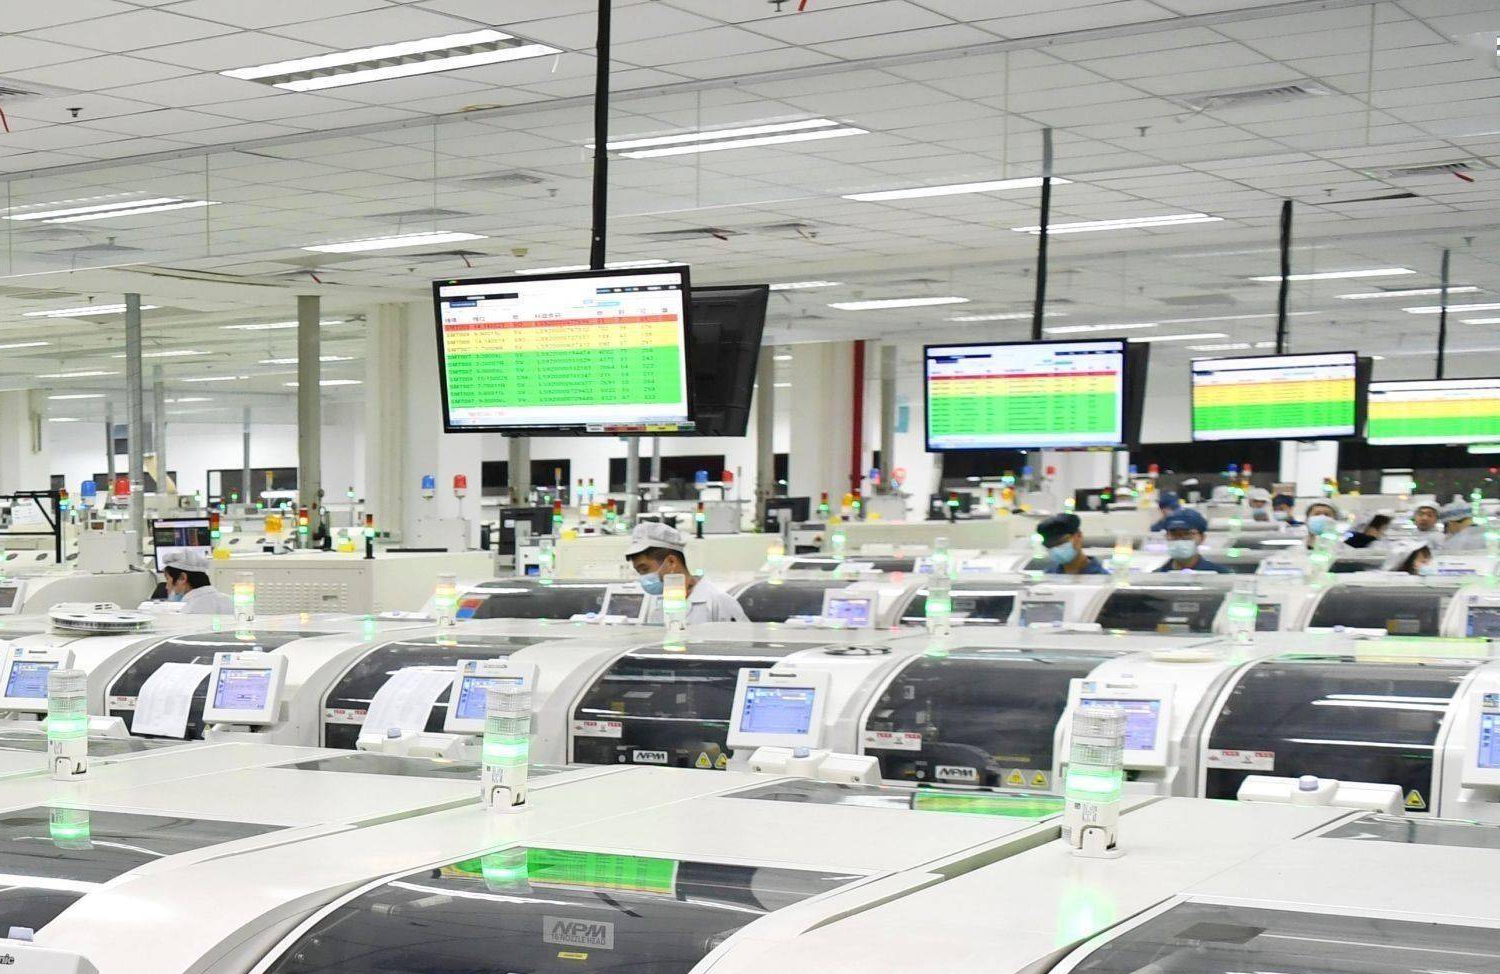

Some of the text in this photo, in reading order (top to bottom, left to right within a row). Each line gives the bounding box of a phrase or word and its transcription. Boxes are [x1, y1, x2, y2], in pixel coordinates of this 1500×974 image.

[636, 752, 665, 760] NPM
[552, 920, 606, 938] NPM
[560, 934, 586, 944] NOZZLE
[587, 936, 606, 946] HEAD
